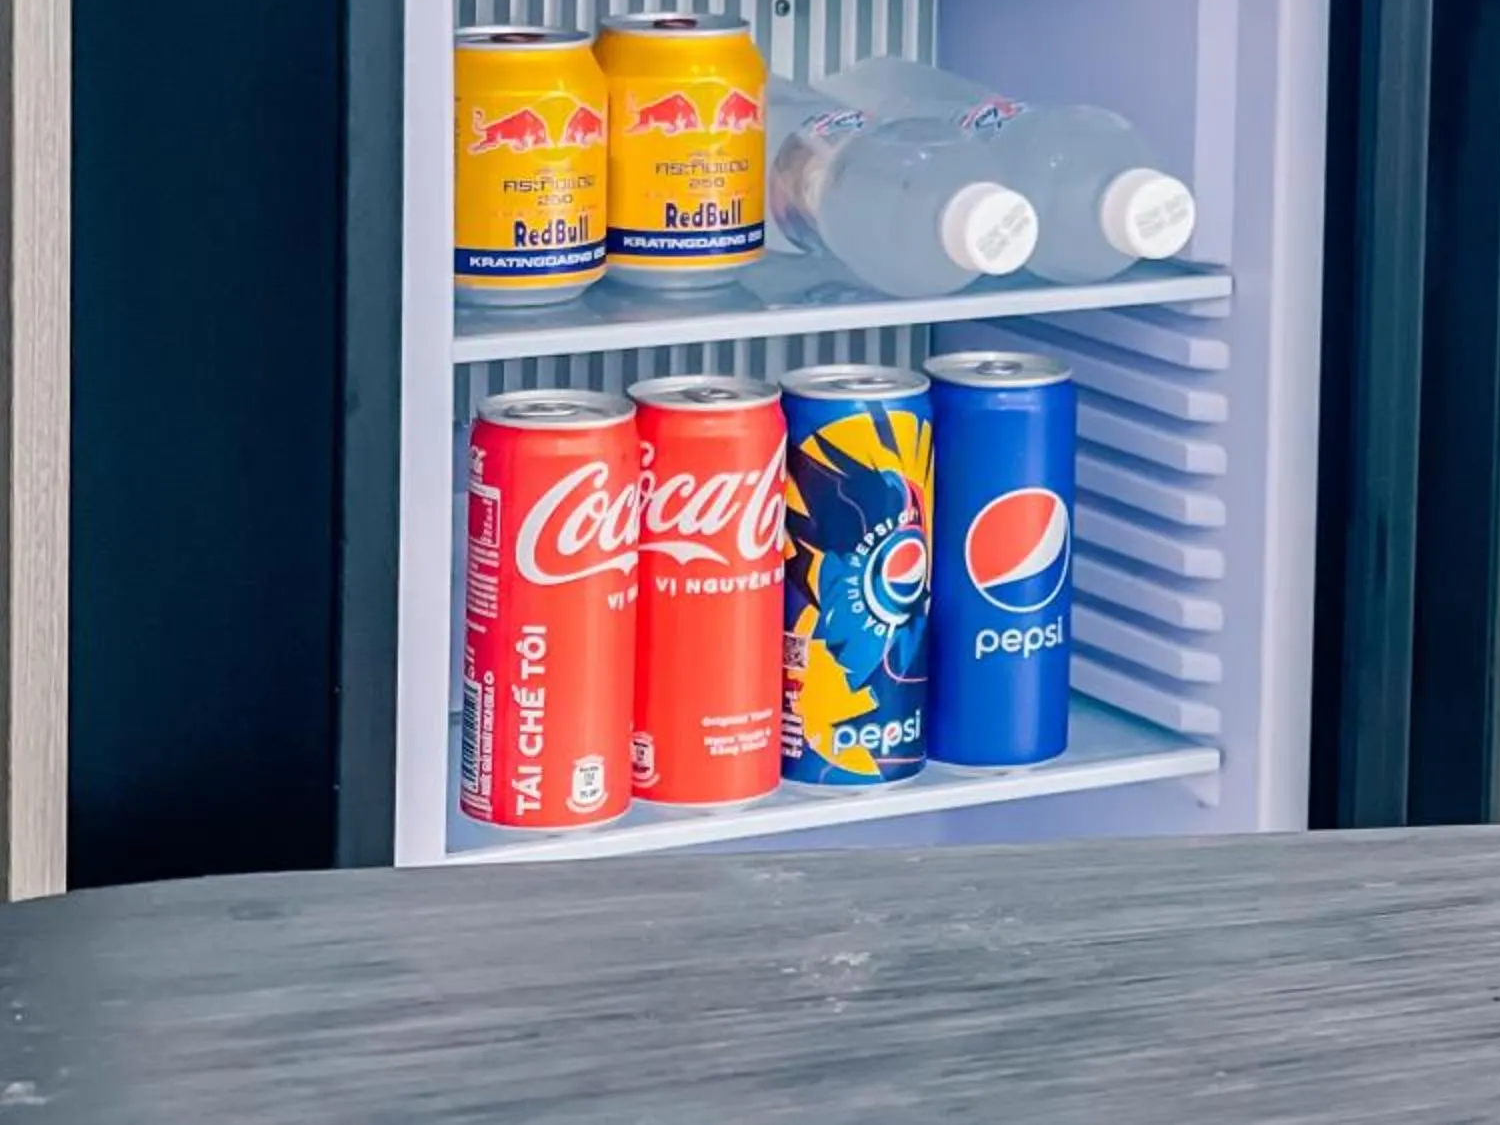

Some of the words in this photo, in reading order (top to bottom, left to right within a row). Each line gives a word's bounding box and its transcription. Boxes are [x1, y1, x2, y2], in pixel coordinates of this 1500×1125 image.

[849, 517, 894, 568] PEPSI
[515, 626, 548, 681] TÔI
[975, 615, 1063, 660] pepsi
[832, 708, 922, 756] pepsi
[512, 765, 543, 816] TÁI
